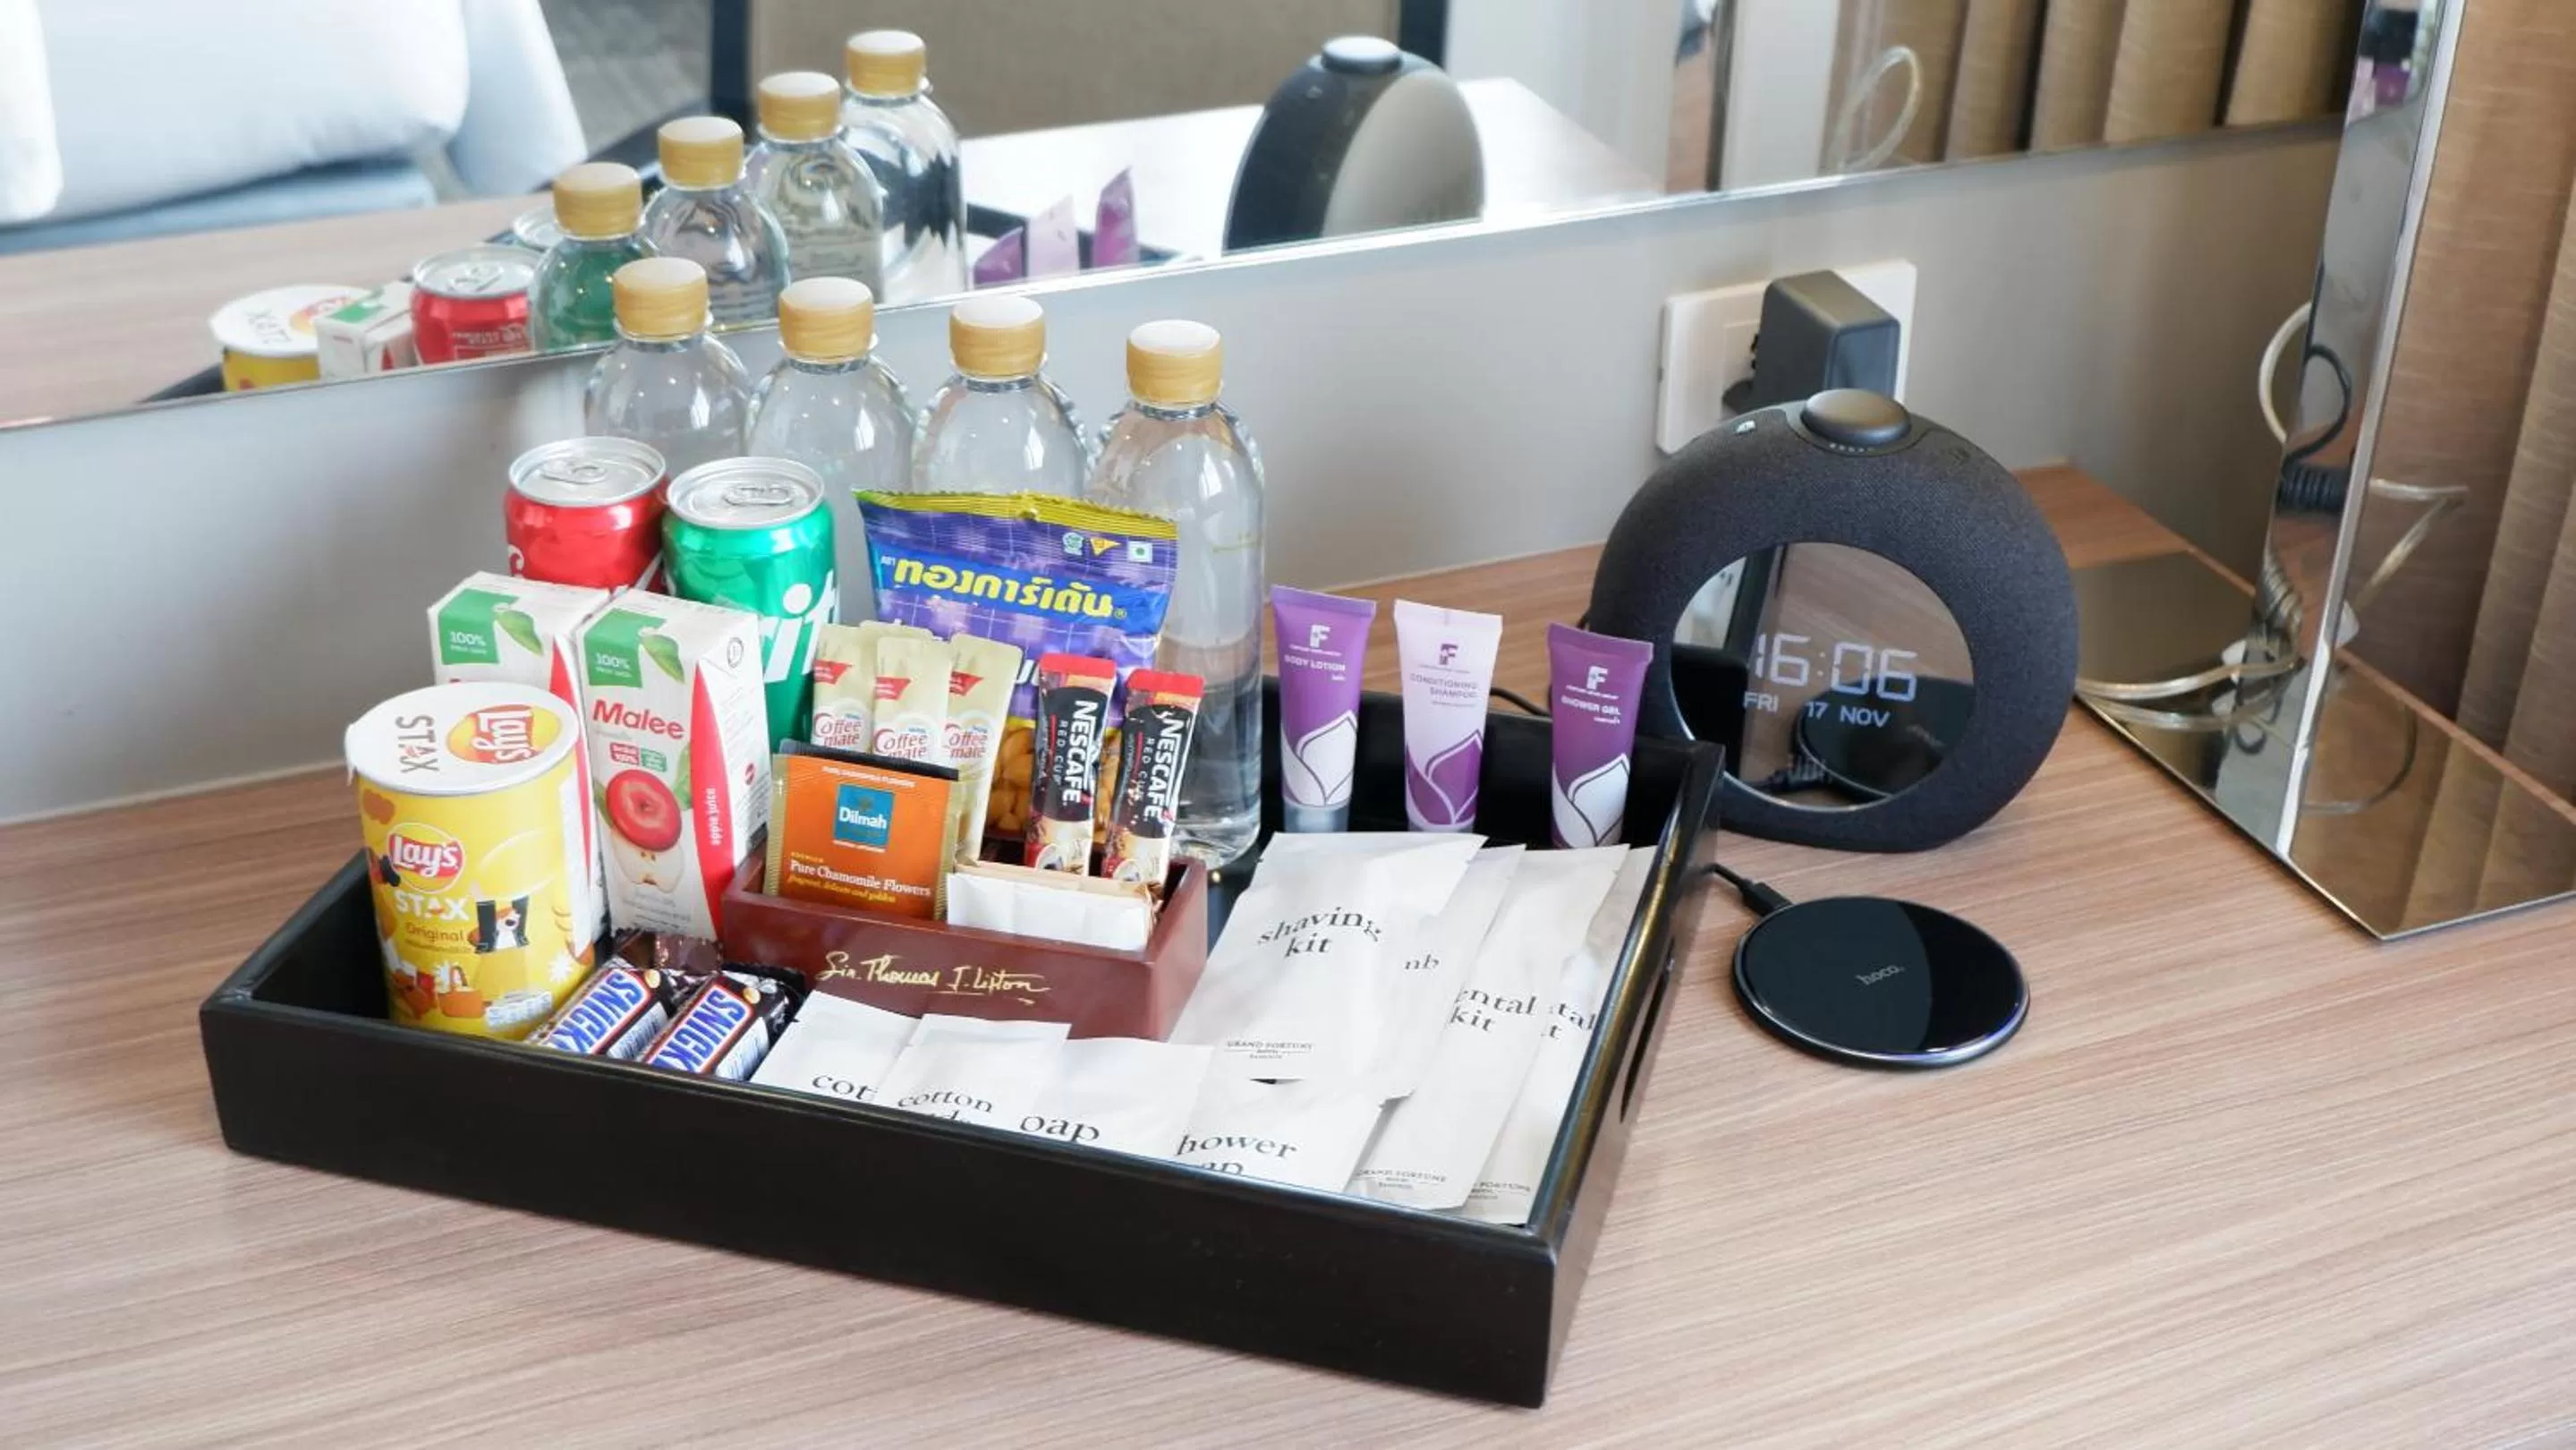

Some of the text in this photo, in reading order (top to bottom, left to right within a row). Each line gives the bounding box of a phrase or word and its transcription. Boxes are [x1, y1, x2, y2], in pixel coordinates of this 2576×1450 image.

[1754, 633, 1917, 702] 16:06
[591, 699, 684, 740] Malee
[814, 712, 862, 738] Coffee
[1743, 691, 1891, 728] FRI 17 NOV
[395, 714, 440, 774] STAX
[872, 728, 929, 754] Coffee
[705, 788, 723, 846] apple juice
[838, 806, 888, 829] Dilmah
[389, 835, 460, 878] Lay's
[790, 859, 931, 897] Pure Chamomile Flowers
[395, 890, 470, 921] STAX
[404, 921, 464, 944] Original
[1257, 906, 1382, 942] shaving
[1285, 933, 1332, 958] kit
[1450, 1006, 1496, 1032] kit
[812, 1075, 878, 1100] cot
[897, 1091, 992, 1113] cotton
